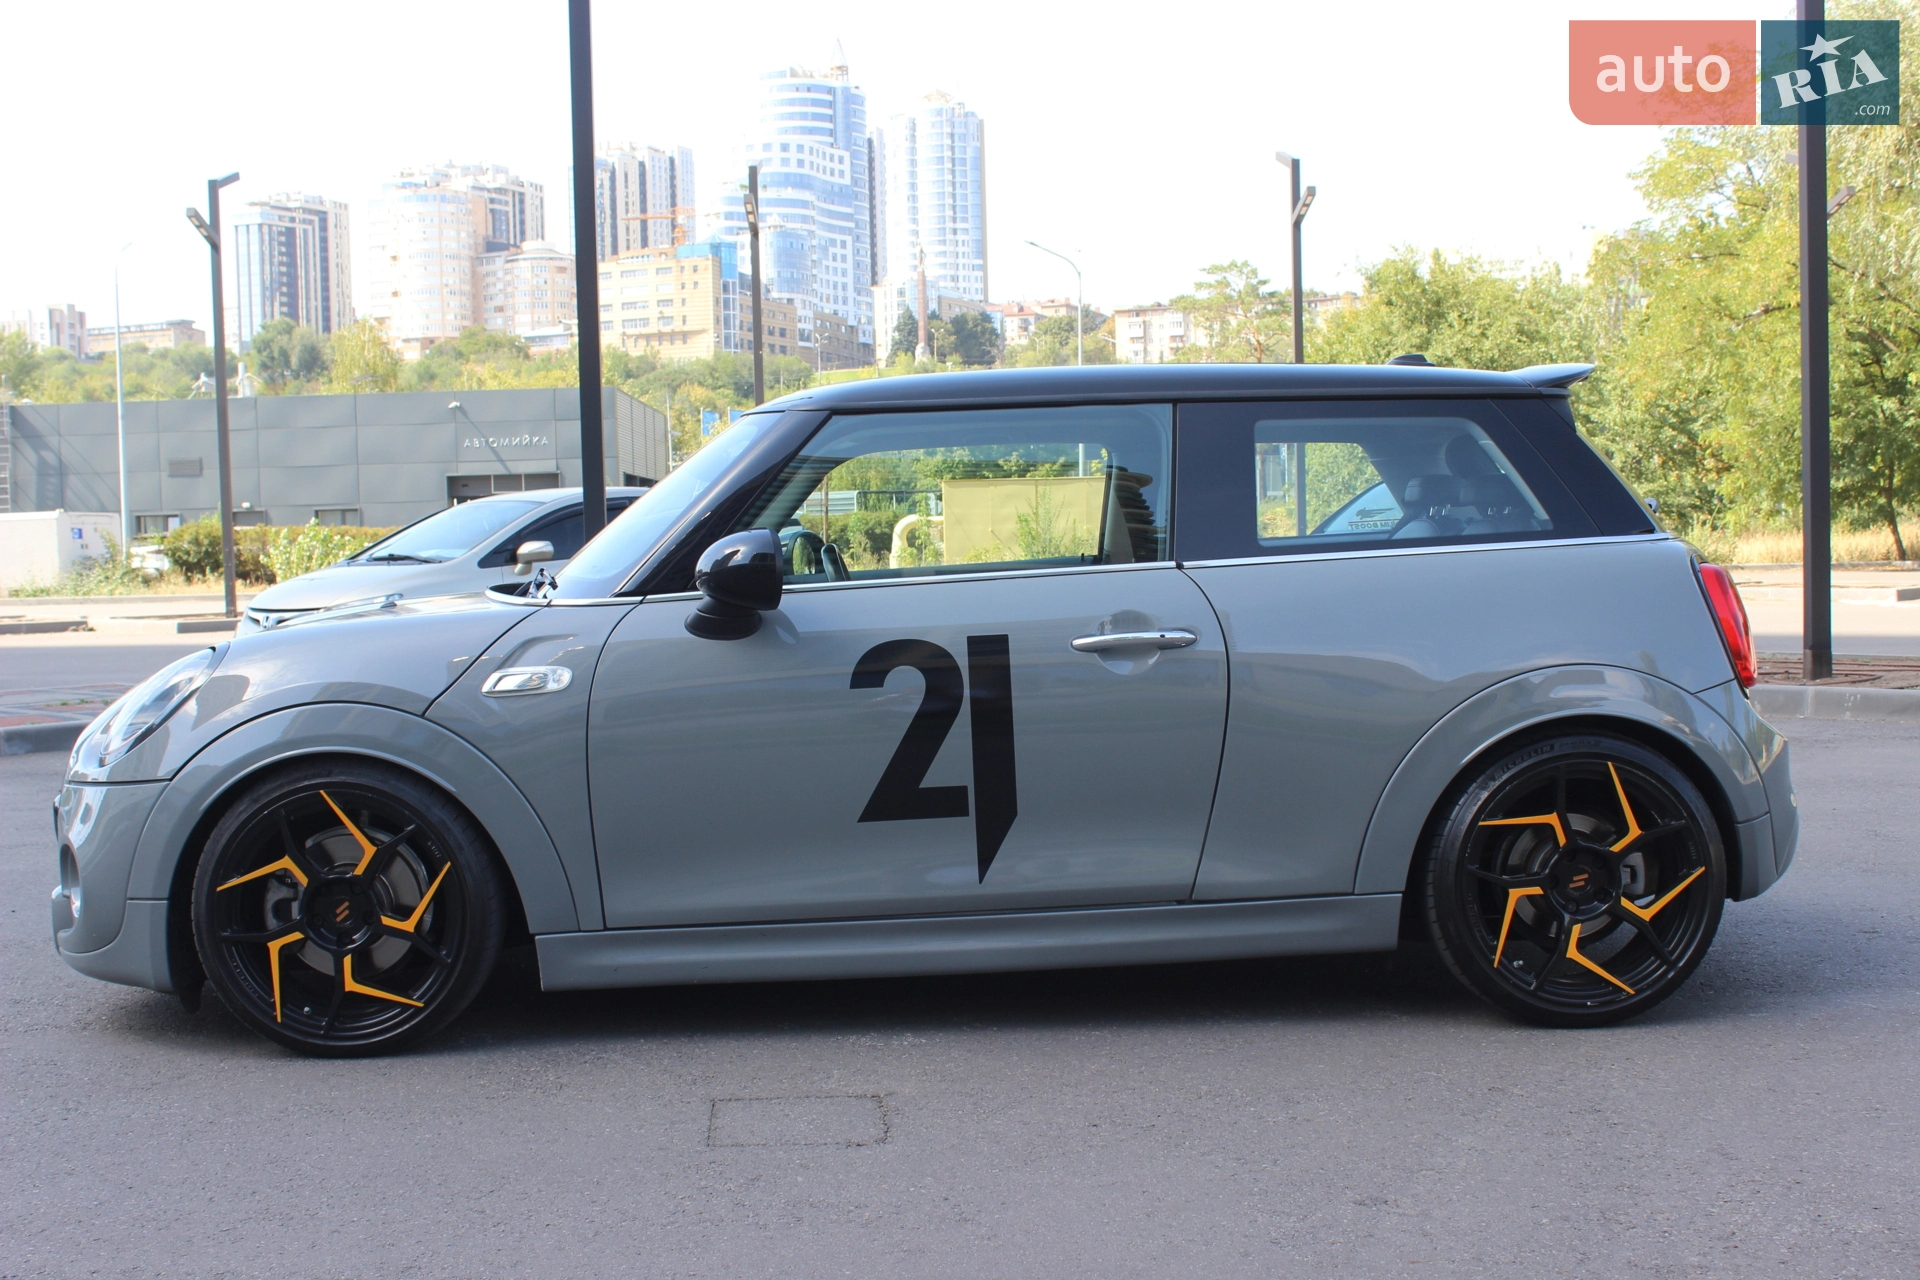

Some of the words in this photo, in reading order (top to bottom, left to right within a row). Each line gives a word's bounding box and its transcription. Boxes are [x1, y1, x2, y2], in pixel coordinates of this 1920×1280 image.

[463, 434, 549, 448] АВТОМИЙКА
[525, 673, 545, 688] S
[849, 634, 1018, 885] 21
[1494, 744, 1552, 780] MICHELIN
